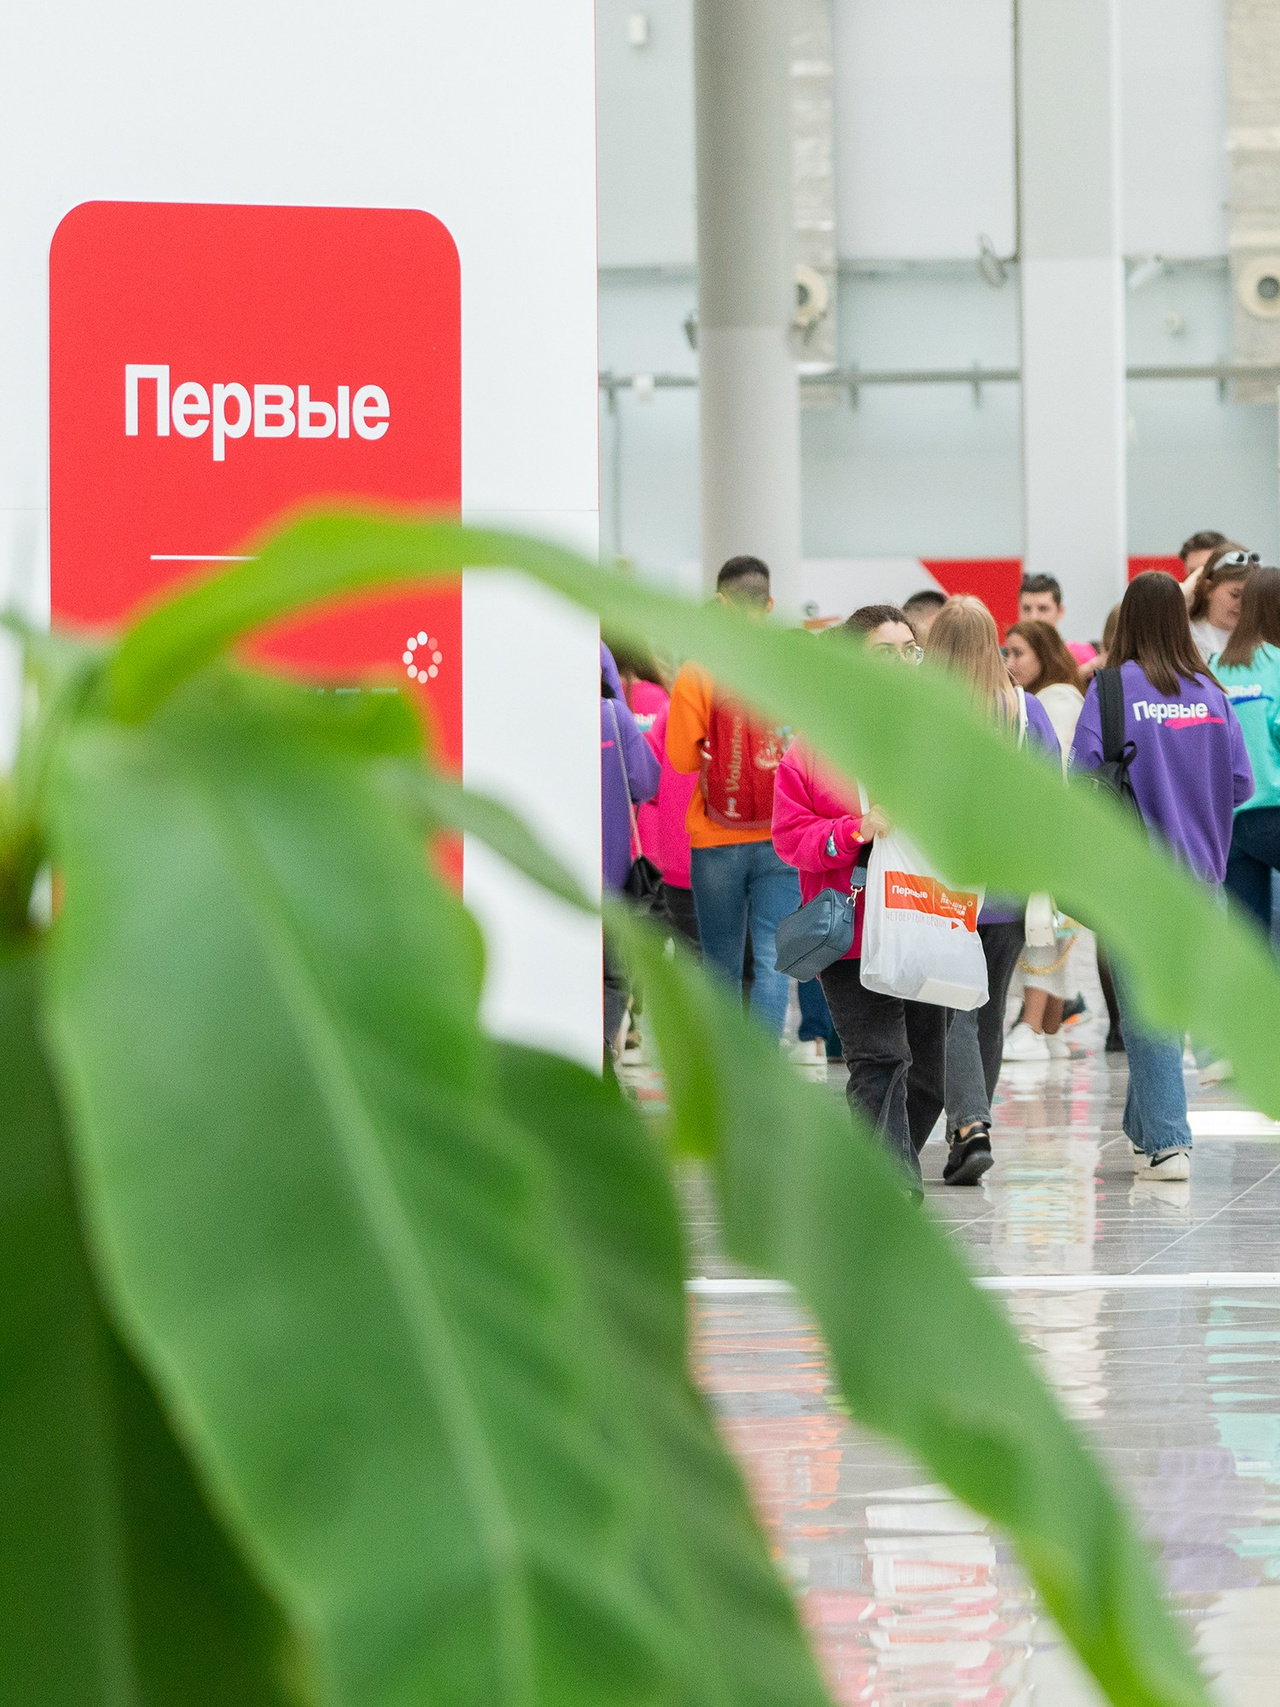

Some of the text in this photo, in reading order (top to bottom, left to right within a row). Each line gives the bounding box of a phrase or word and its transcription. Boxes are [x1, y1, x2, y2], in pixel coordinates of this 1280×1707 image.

[125, 363, 390, 461] Первые
[1132, 700, 1210, 725] Первые
[891, 885, 928, 899] Первые
